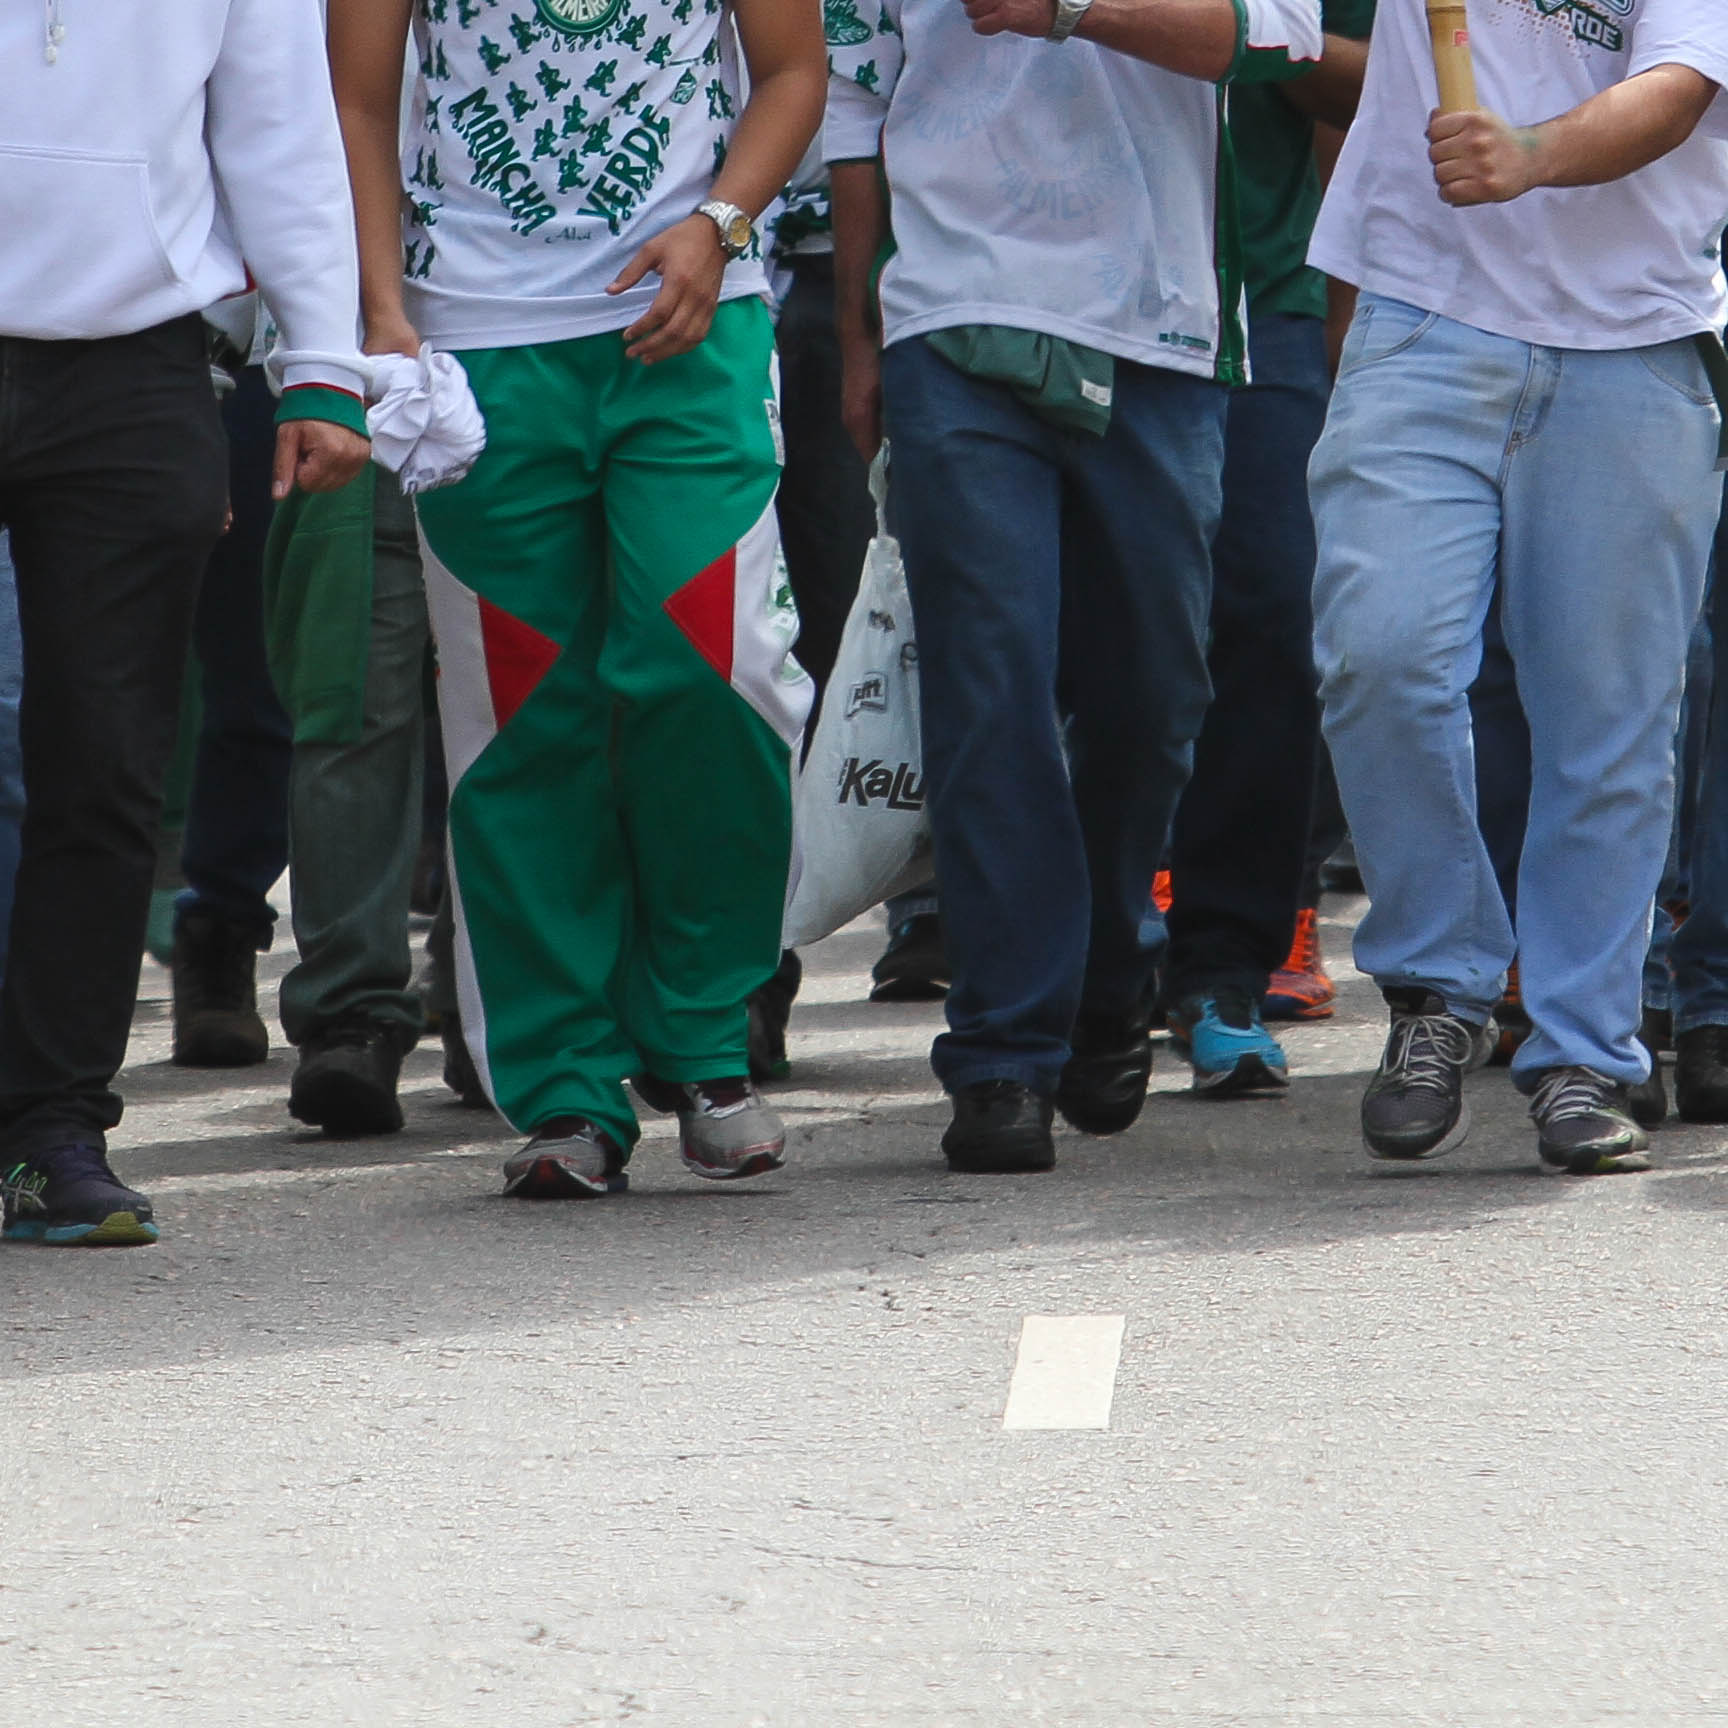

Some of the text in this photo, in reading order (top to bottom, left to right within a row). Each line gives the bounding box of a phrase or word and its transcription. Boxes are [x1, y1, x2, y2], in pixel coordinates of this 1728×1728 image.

[1571, 7, 1618, 49] RDE
[449, 87, 670, 237] MANCHA VERDE
